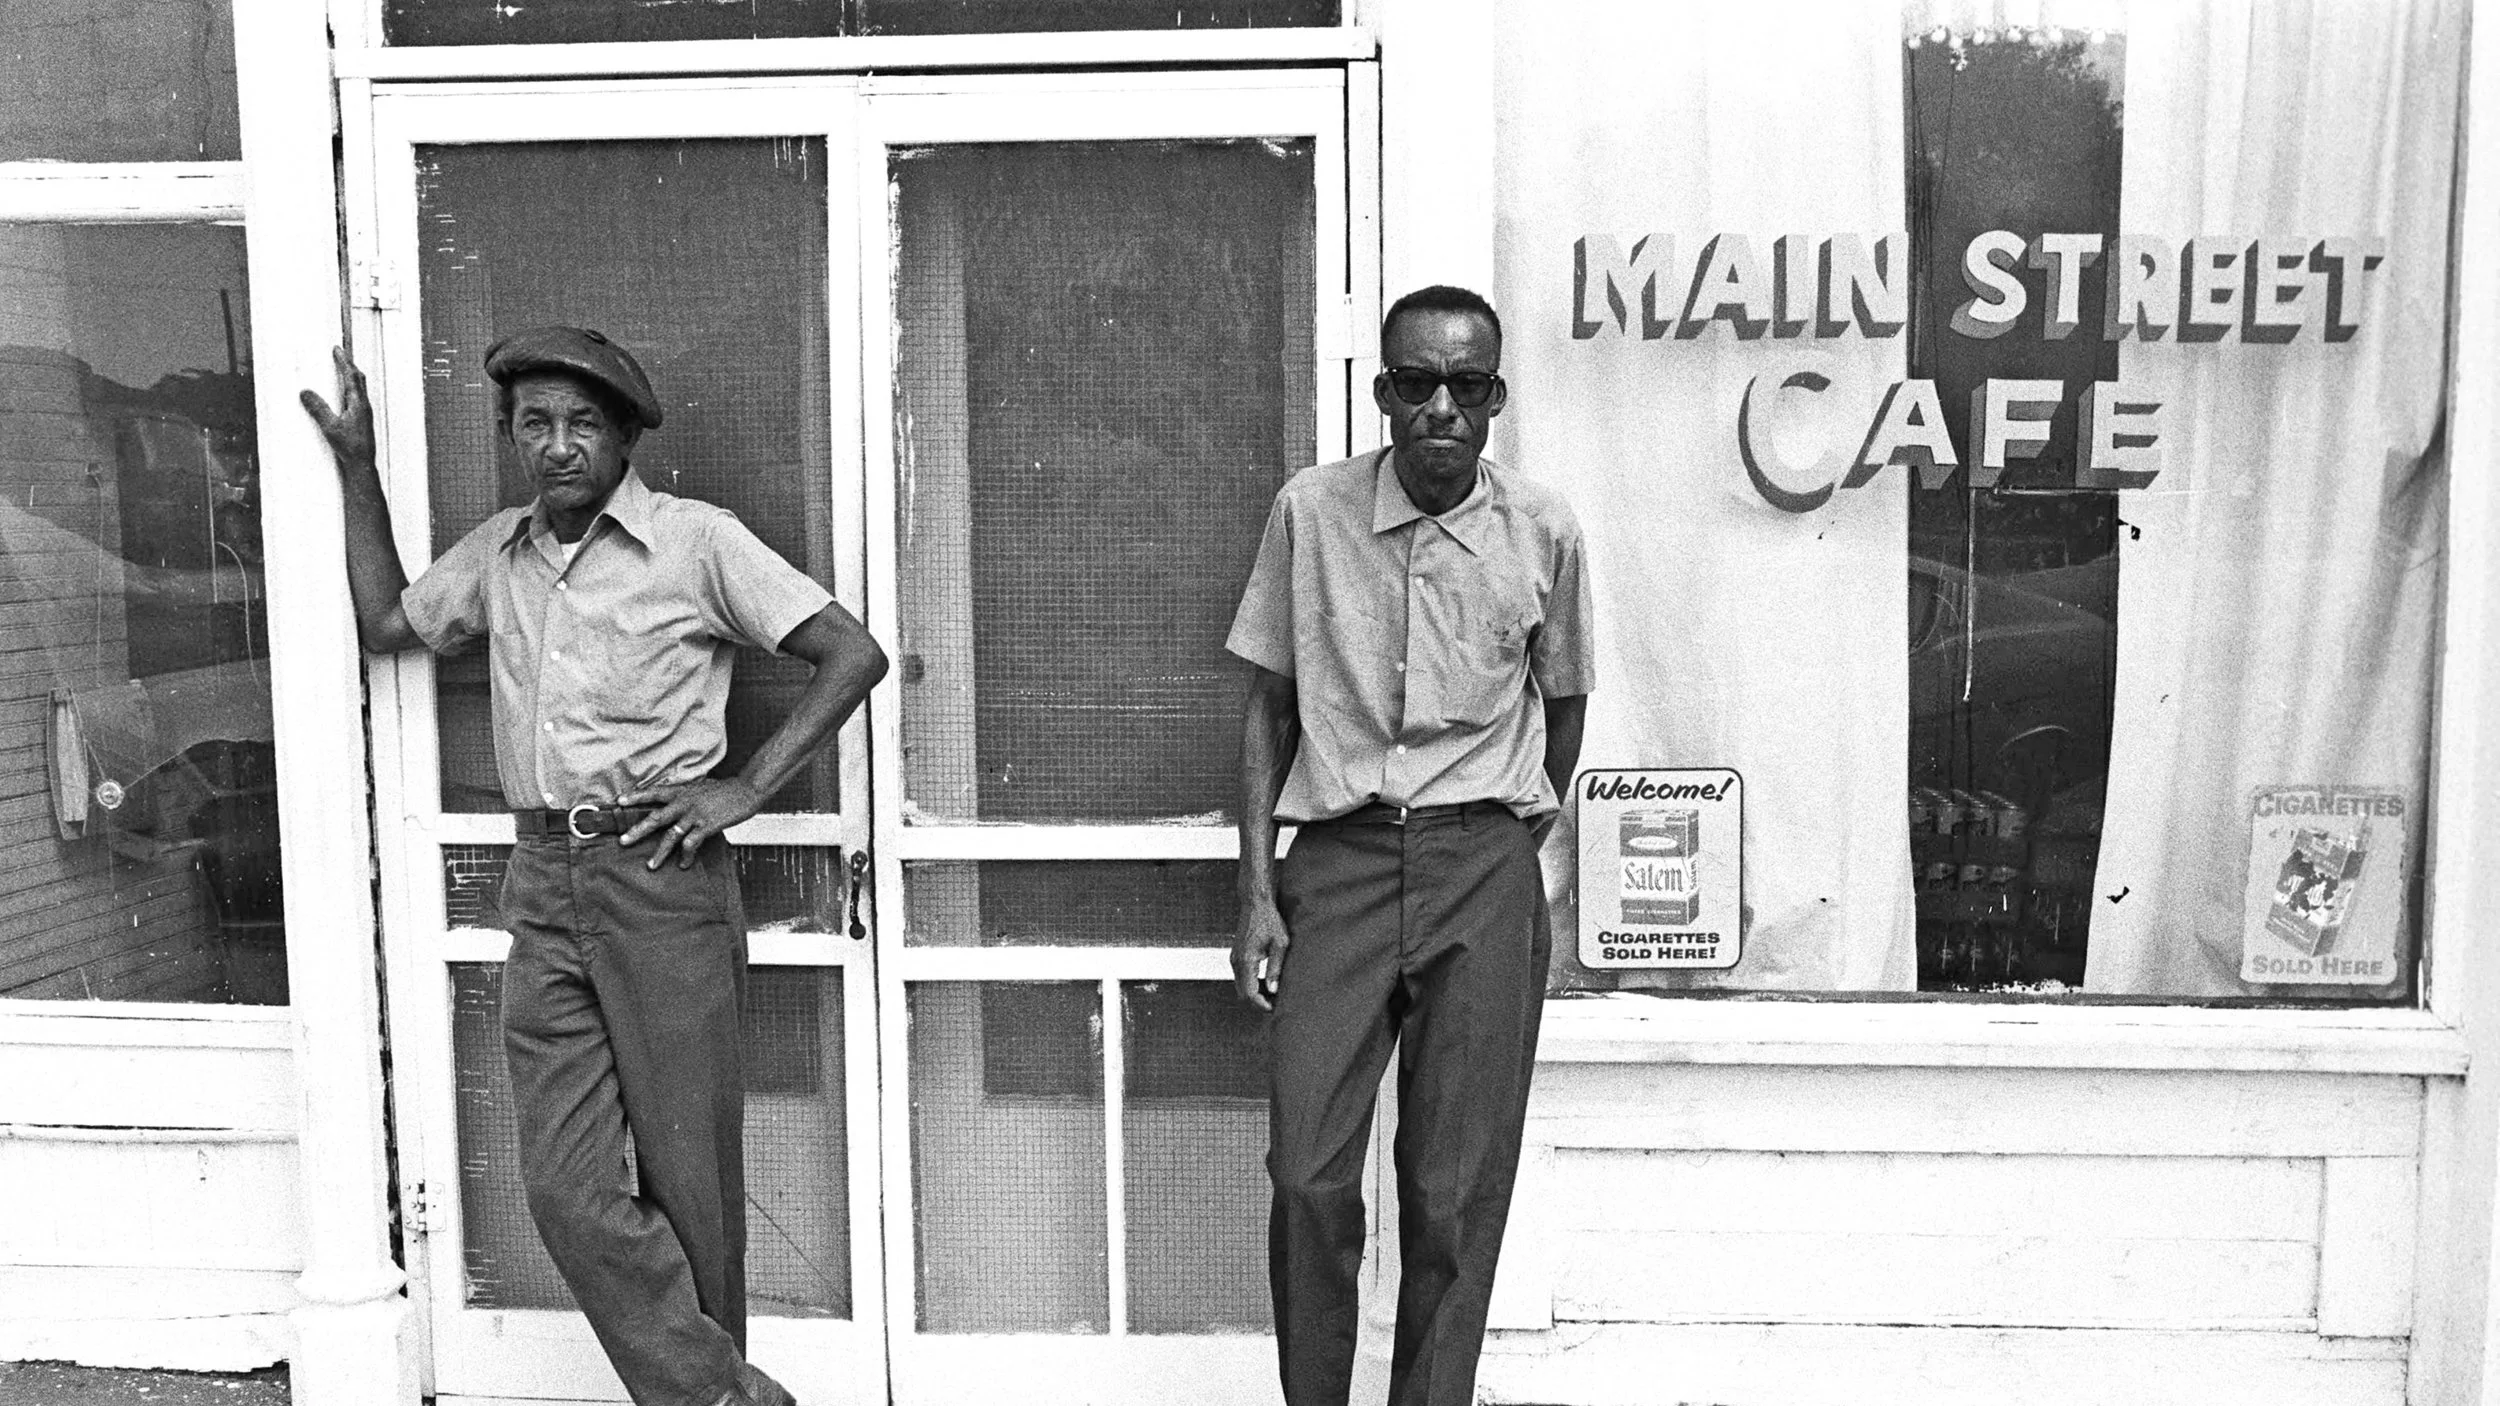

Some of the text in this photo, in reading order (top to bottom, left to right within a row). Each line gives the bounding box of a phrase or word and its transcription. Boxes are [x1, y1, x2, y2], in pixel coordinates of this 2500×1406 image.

[1572, 231, 2385, 342] MAIN STREET
[1737, 350, 2161, 513] CAFE
[1586, 775, 1734, 801] Welcome!
[2256, 794, 2401, 817] CIGARETTES
[1624, 861, 1683, 892] Salem
[1598, 931, 1720, 944] CIGARETTES
[1602, 947, 1716, 960] SOLD HERE!
[2253, 954, 2383, 975] SOLD HERE
